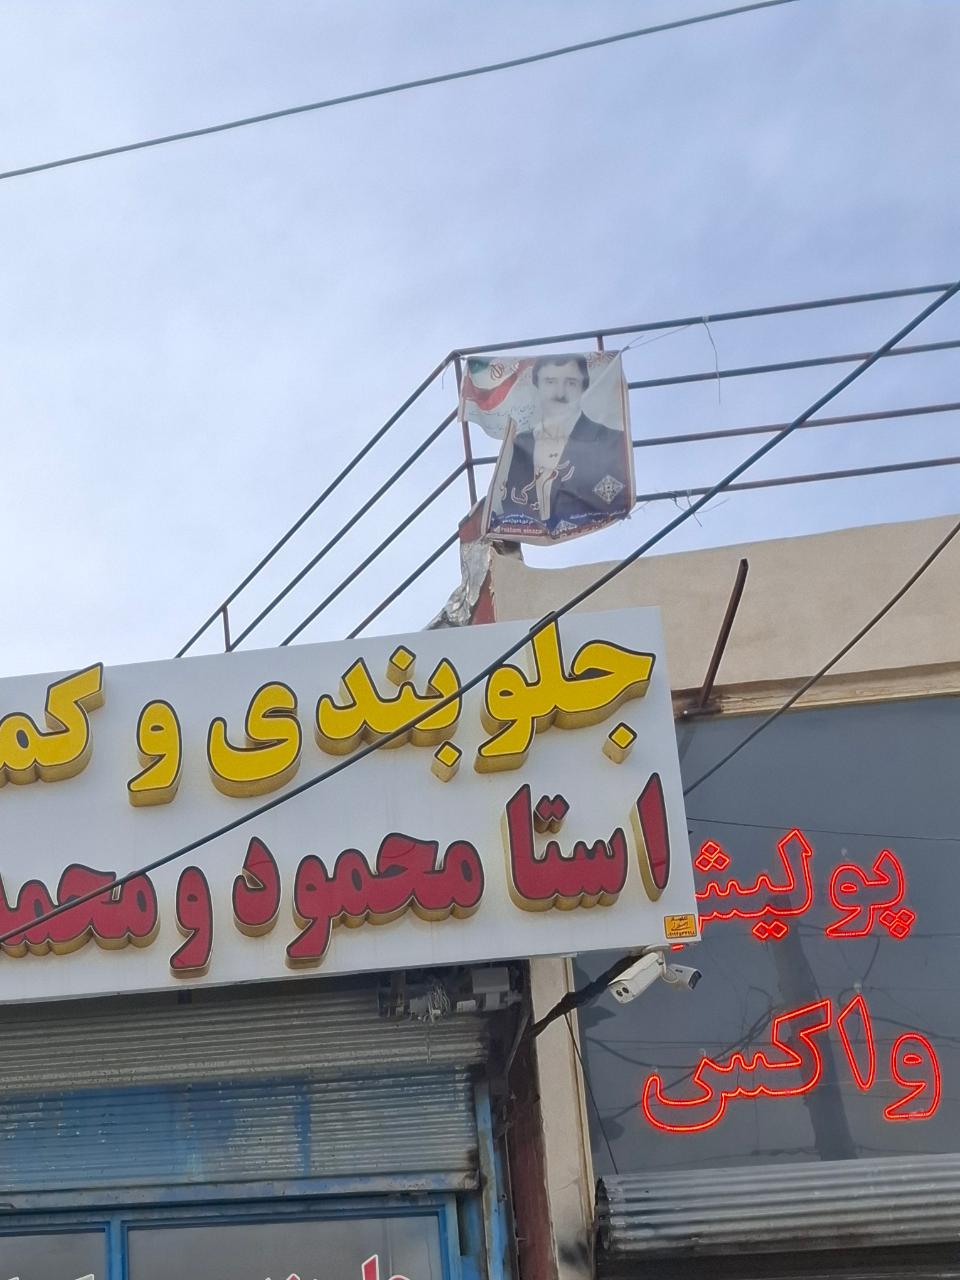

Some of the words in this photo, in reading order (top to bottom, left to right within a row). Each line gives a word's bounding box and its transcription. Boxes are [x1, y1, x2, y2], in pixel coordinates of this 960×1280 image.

[128, 700, 184, 807] و
[232, 832, 485, 970] محمود
[504, 772, 670, 912] استا
[170, 866, 214, 978] و
[642, 994, 942, 1132] واکس
